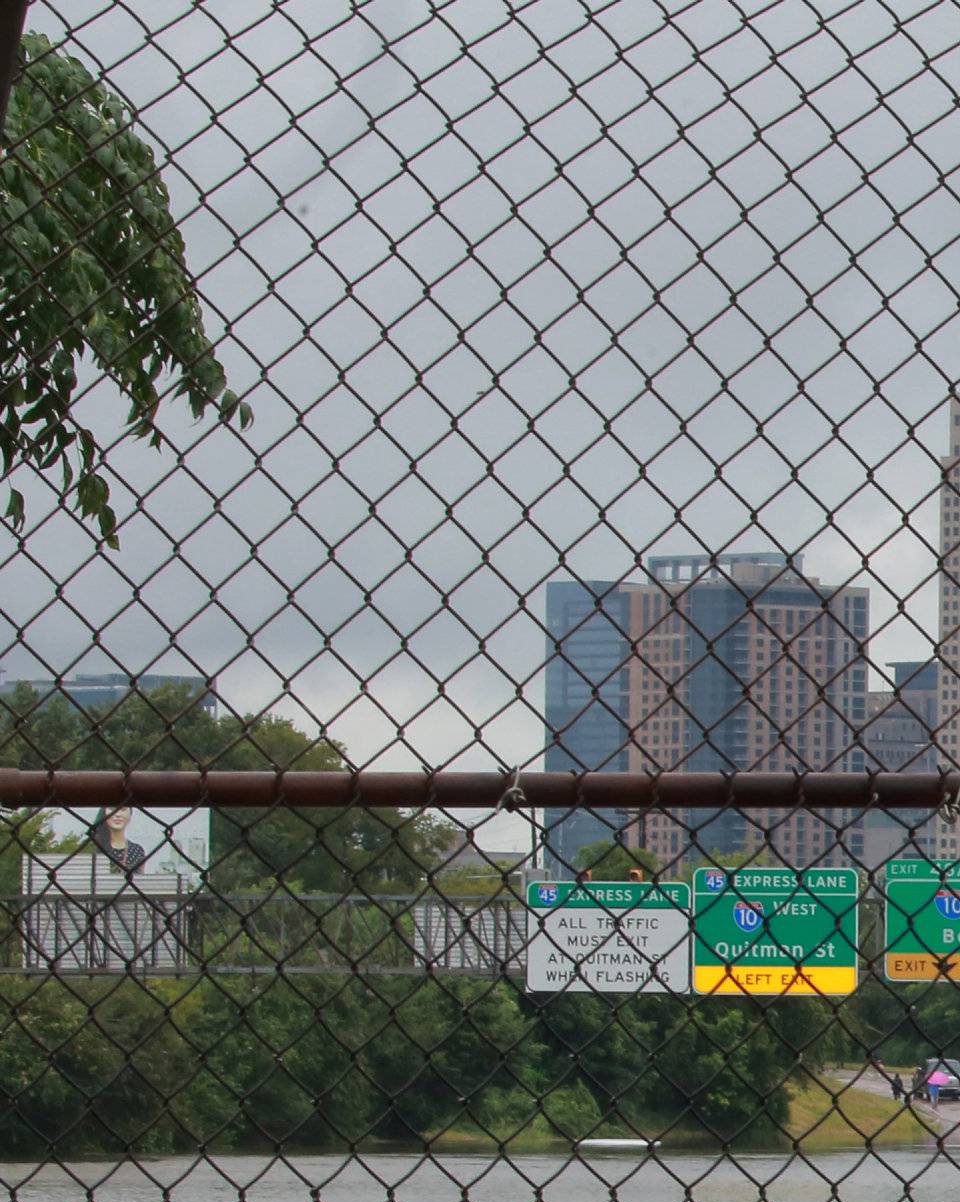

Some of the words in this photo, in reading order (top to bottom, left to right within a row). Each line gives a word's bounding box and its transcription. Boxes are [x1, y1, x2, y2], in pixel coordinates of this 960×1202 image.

[890, 864, 918, 875] EXIT
[706, 876, 724, 888] 45
[734, 876, 798, 888] EXPRESS
[807, 876, 848, 888] LANE
[539, 890, 557, 902] 45
[567, 889, 633, 902] EXPRESS
[640, 890, 680, 902] LANE
[557, 917, 587, 929] ALL
[596, 917, 660, 929] TRAFFIC
[739, 908, 758, 926] 10
[567, 936, 607, 947] MUST
[617, 936, 649, 947] EXIT
[715, 941, 804, 958] Quitman
[815, 942, 835, 958] St
[547, 953, 565, 965] AT
[575, 953, 642, 965] QUITMAN
[652, 953, 668, 965] ST
[894, 960, 928, 972] EXIT
[546, 971, 589, 982] WHEN
[596, 971, 670, 983] FLASHIG
[735, 974, 773, 985] LEFT
[781, 974, 813, 985] EXIT
